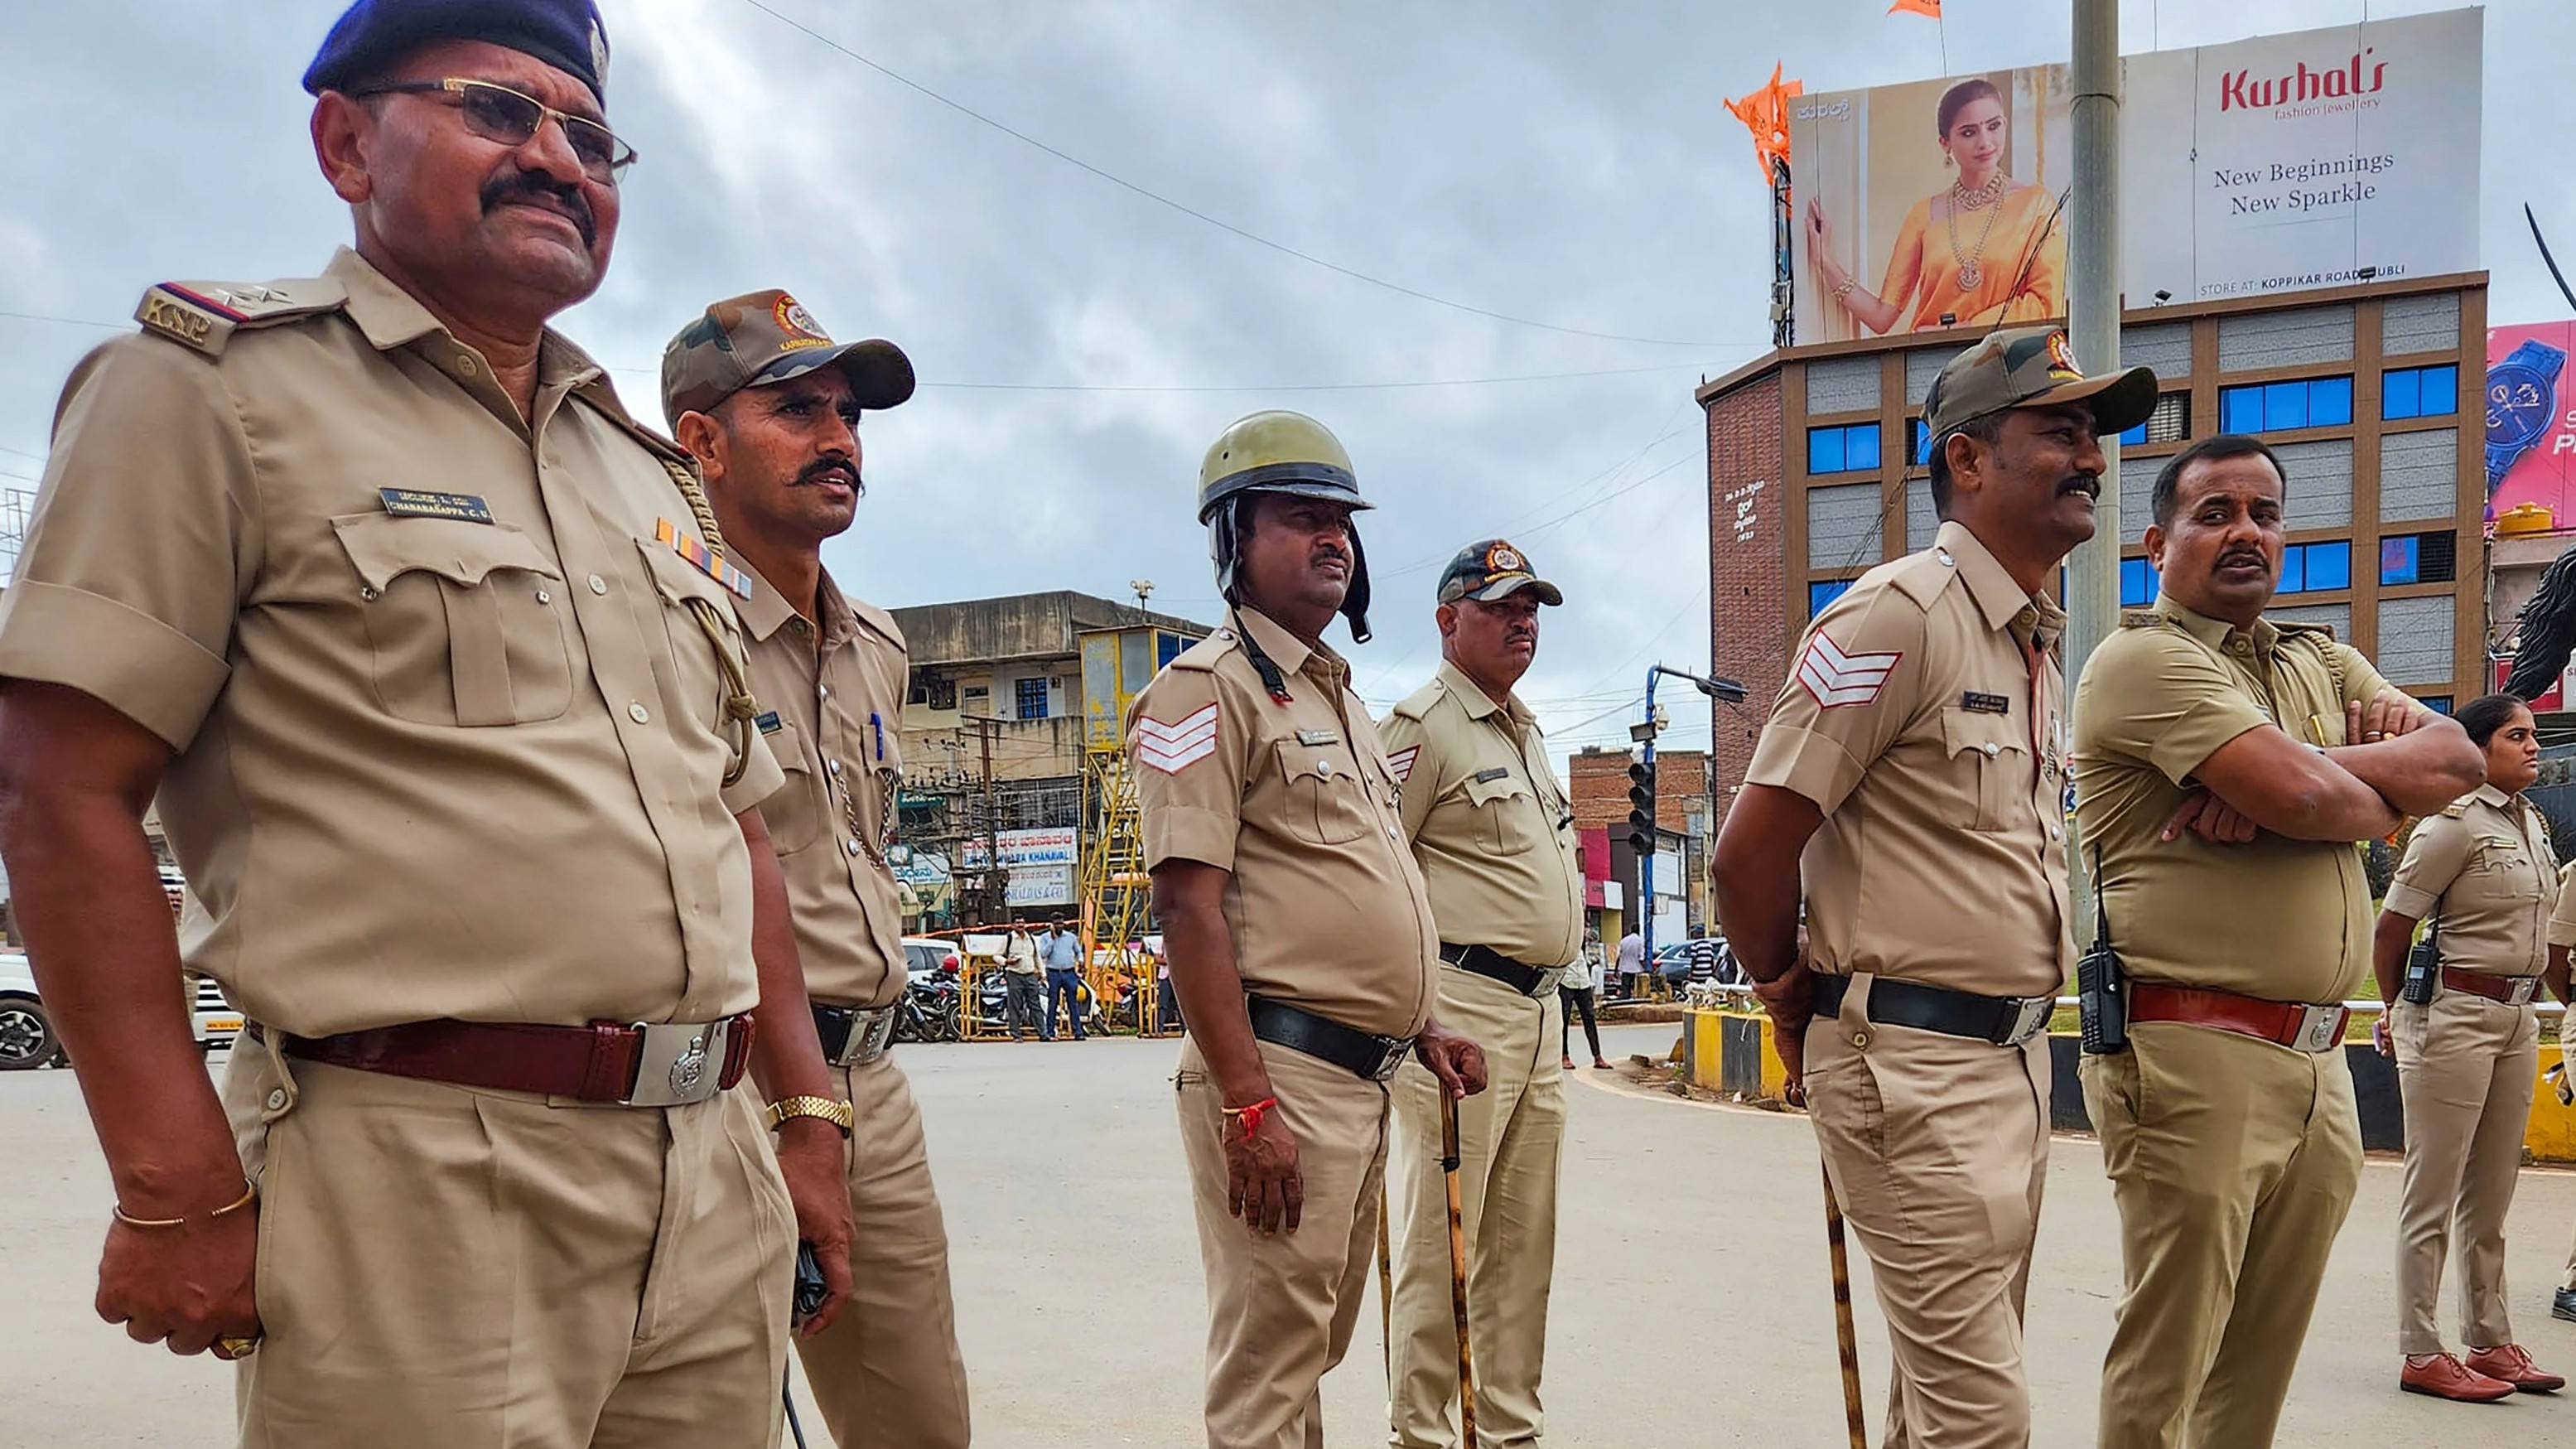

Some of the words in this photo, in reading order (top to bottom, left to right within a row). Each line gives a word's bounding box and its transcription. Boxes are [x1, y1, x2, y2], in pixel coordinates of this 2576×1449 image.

[2221, 47, 2389, 112] Kushal's
[2275, 106, 2320, 120] fashion
[2323, 98, 2381, 115] jewellery
[2214, 170, 2261, 188] New
[2270, 154, 2394, 182] Beginnings
[2231, 196, 2279, 215] New
[2289, 181, 2376, 211] Sparkle
[2201, 283, 2236, 296] STORE
[2241, 281, 2257, 291] AT:
[2262, 273, 2321, 289] KOPPIKAR
[2371, 264, 2405, 278] UBLI
[138, 296, 211, 344] KSP
